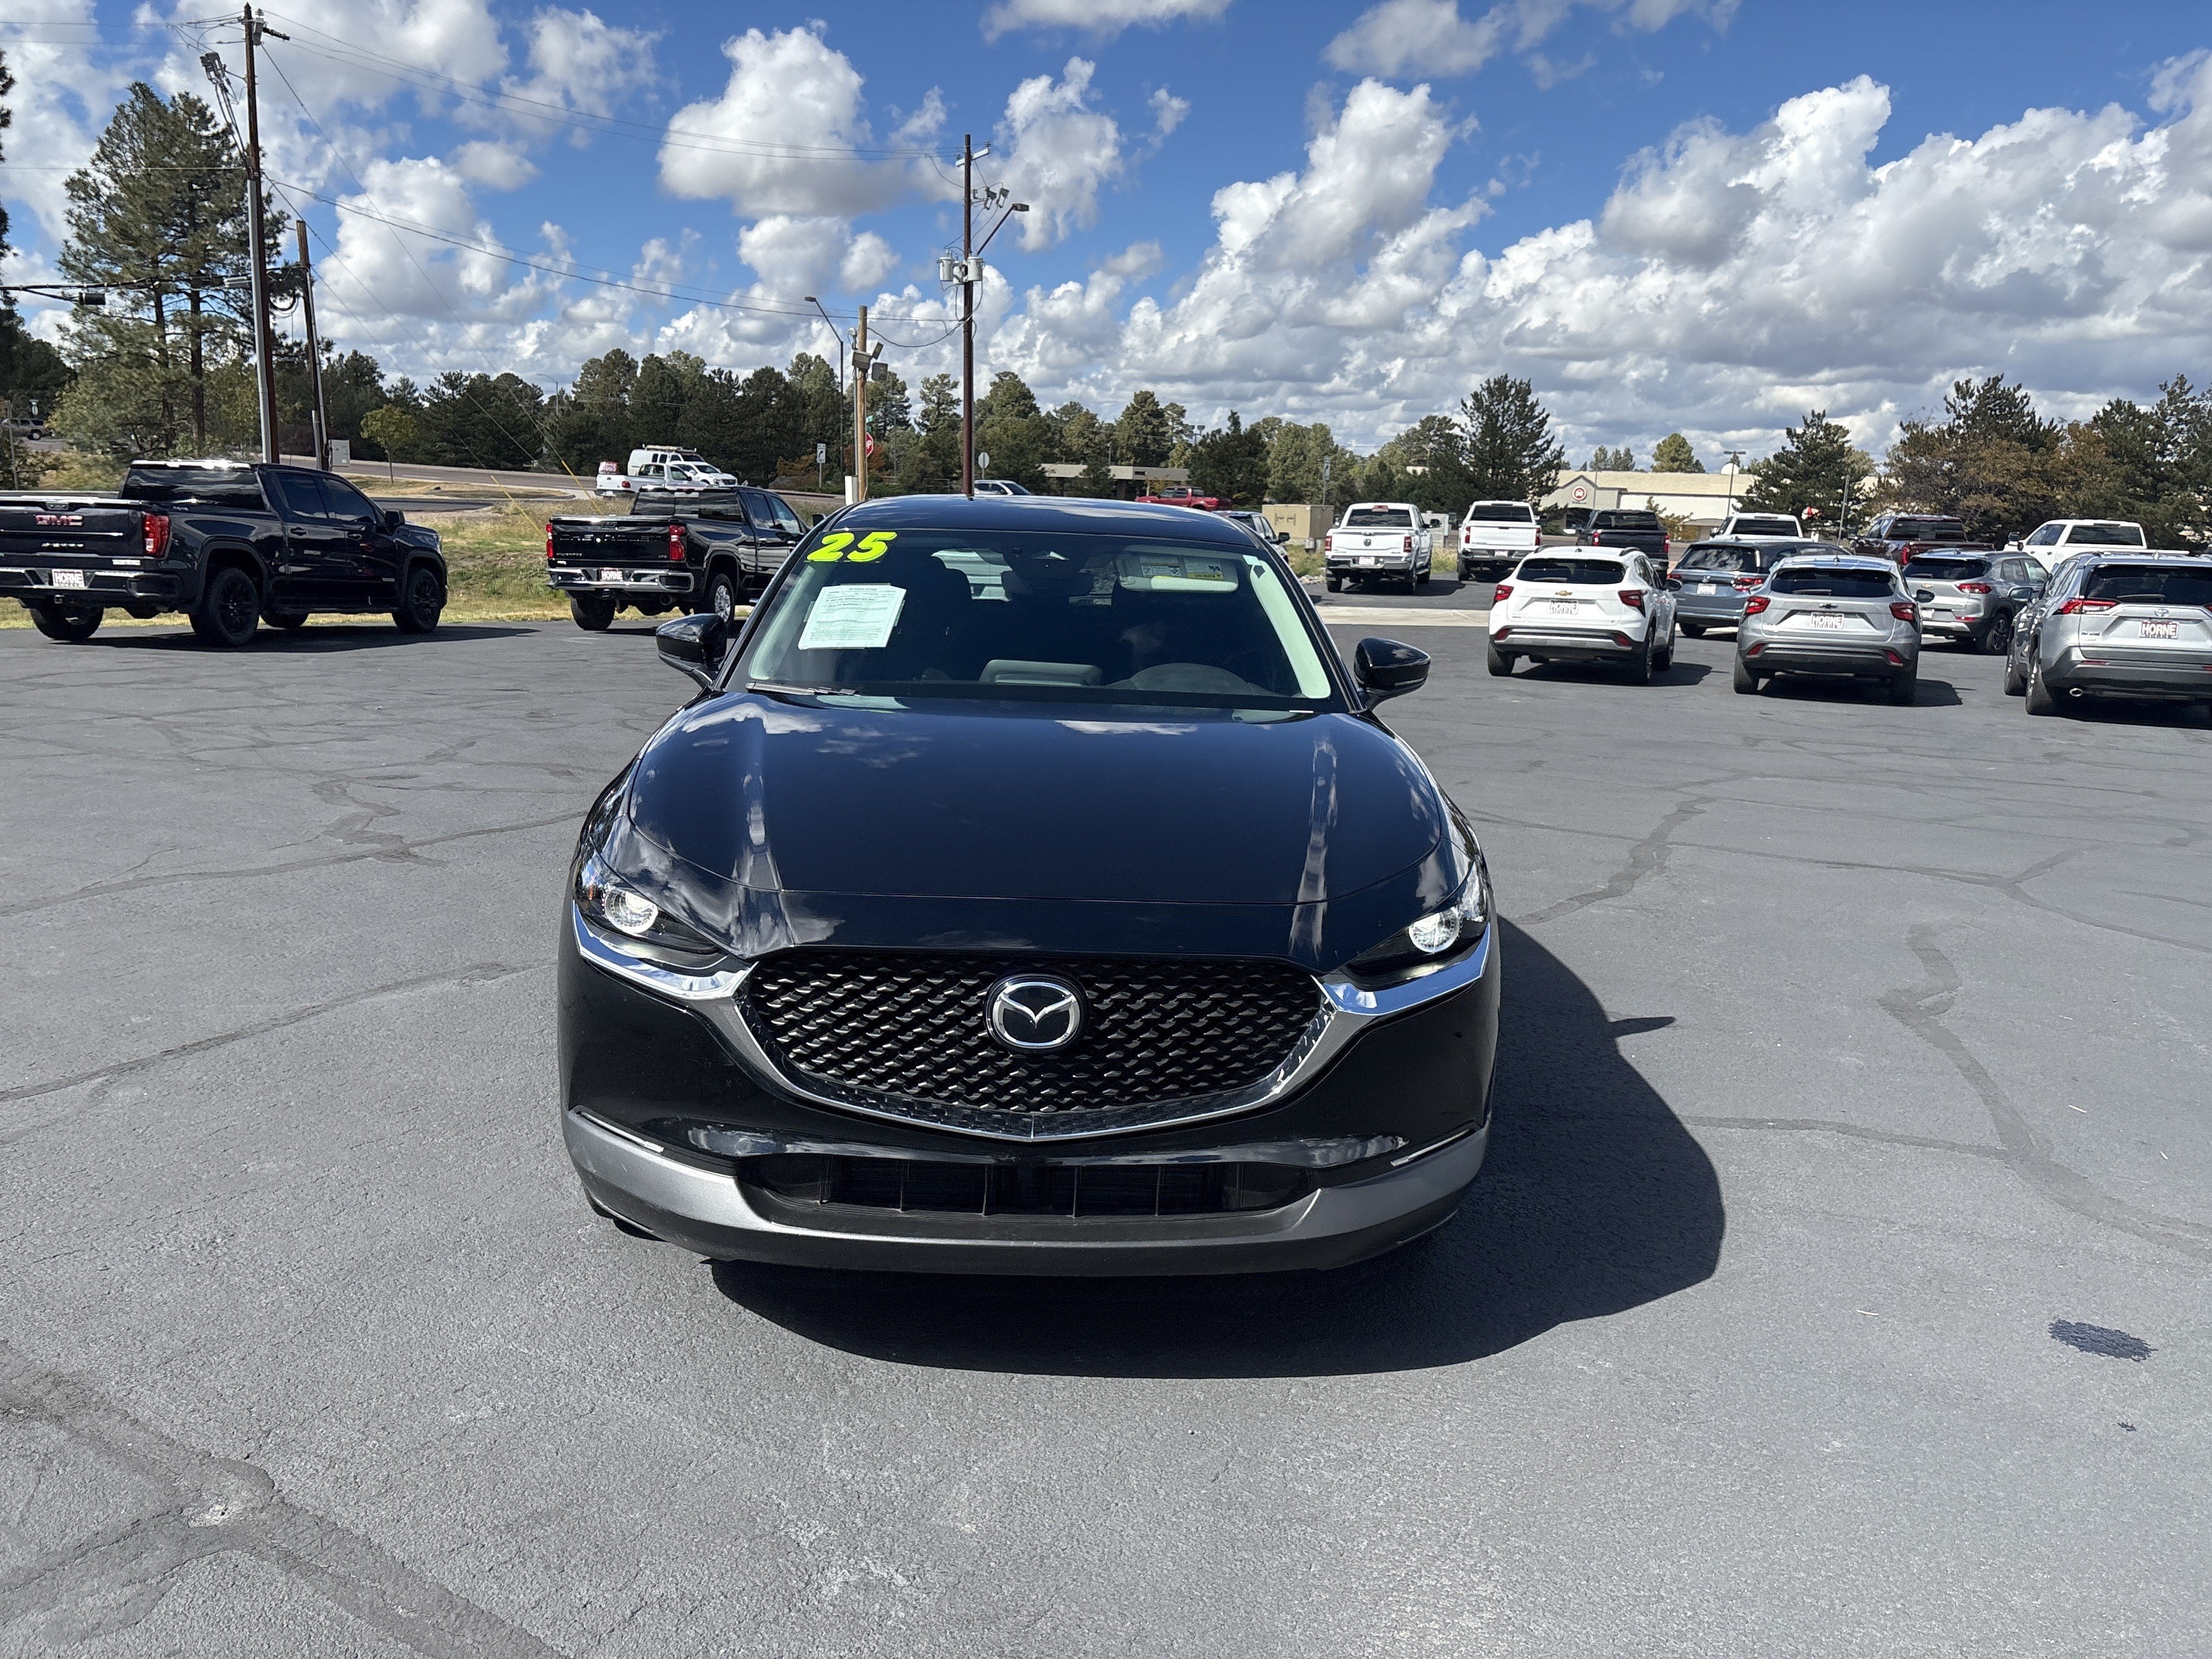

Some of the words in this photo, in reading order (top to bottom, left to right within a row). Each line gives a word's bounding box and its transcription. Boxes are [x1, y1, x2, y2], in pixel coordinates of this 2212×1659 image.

[807, 532, 897, 562] 25
[54, 572, 82, 584] HORNE
[601, 571, 623, 580] HORNE
[1812, 616, 1842, 626] HORNE
[2142, 623, 2176, 635] HORNE
